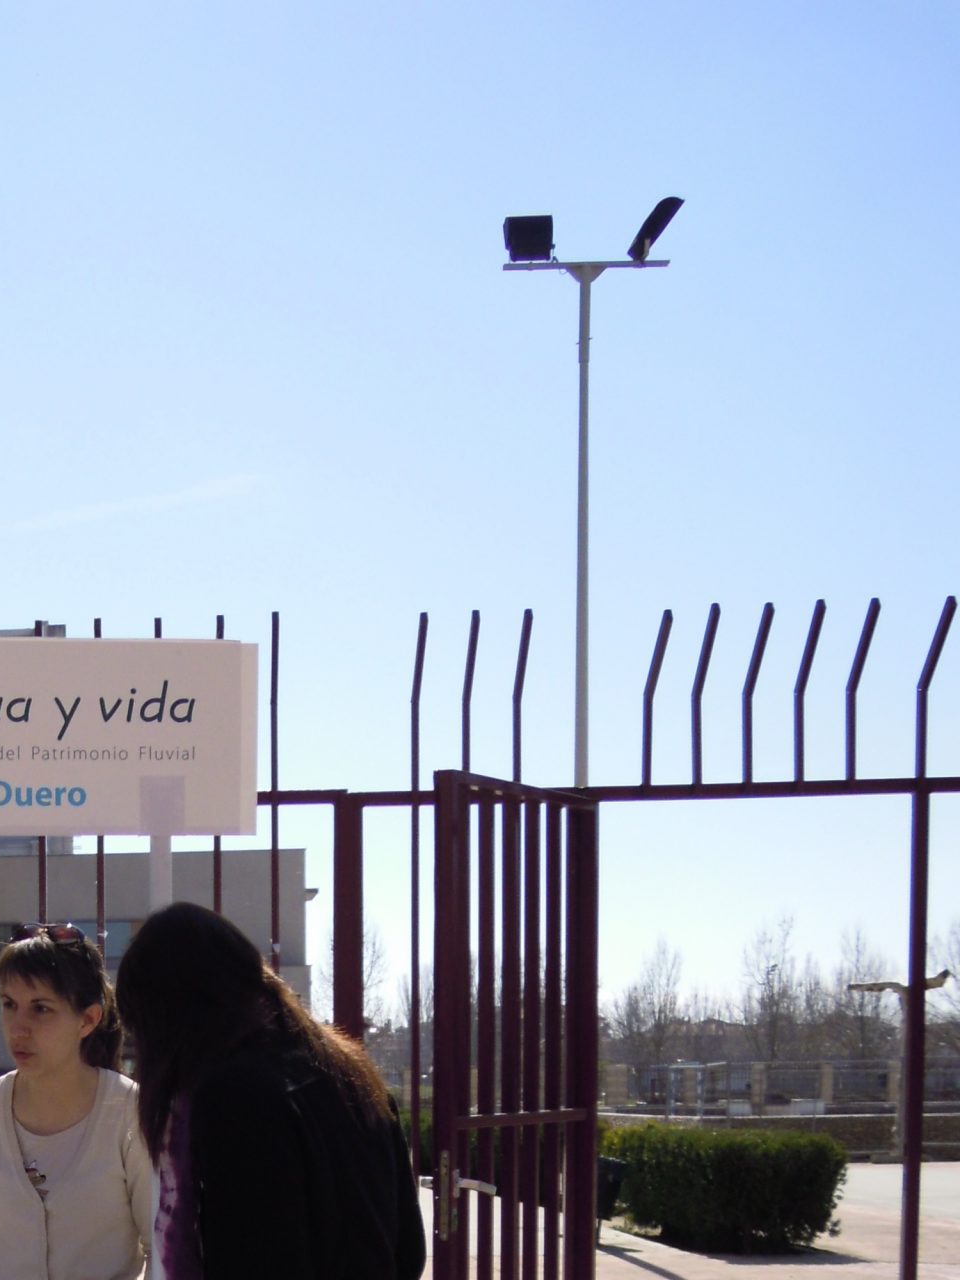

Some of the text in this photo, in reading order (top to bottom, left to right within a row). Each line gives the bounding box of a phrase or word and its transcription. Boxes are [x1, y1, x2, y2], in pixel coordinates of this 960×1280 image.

[54, 695, 81, 741] y
[99, 680, 196, 723] vida
[31, 746, 128, 761] Patrimonio
[139, 746, 196, 760] Fluvial
